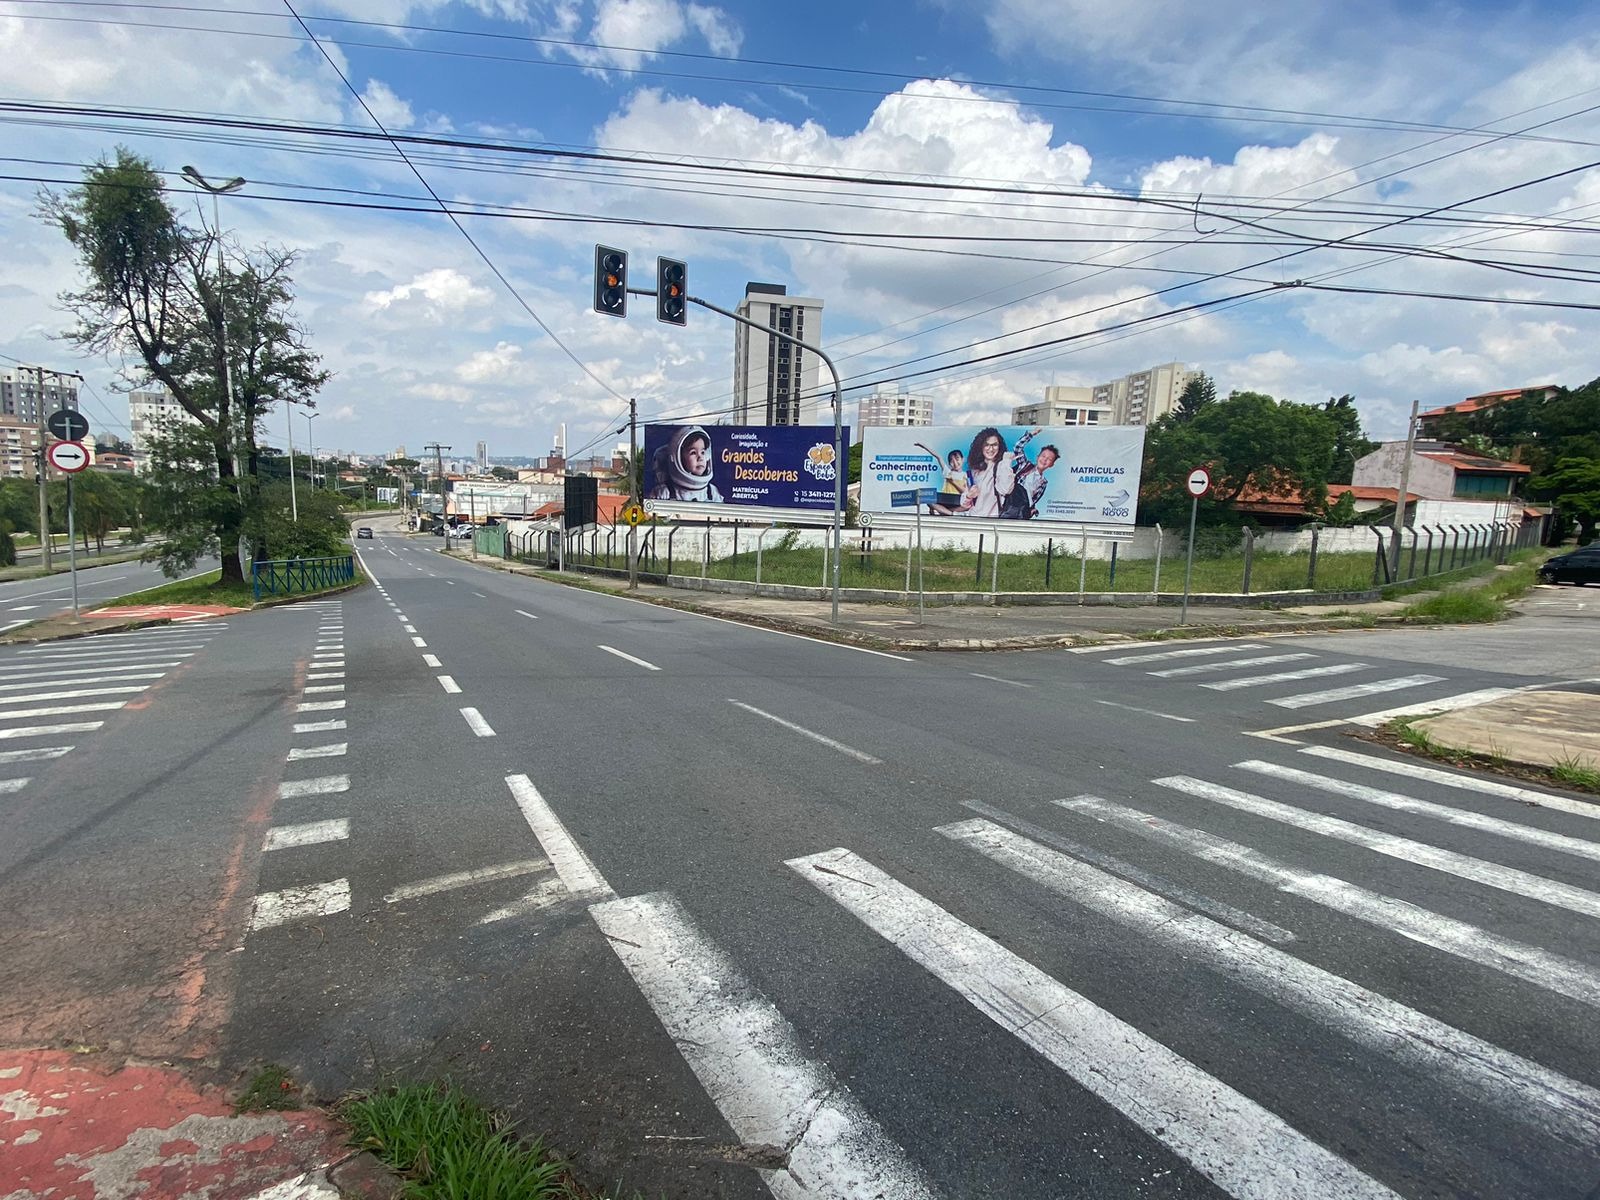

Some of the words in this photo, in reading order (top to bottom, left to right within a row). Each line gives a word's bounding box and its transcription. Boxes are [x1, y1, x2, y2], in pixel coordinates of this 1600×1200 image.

[722, 448, 764, 464] Grandes
[869, 462, 938, 471] Conhecimento
[1071, 465, 1125, 474] MATRÍCULAS
[735, 465, 798, 481] Descobertas
[877, 473, 893, 481] em
[897, 472, 929, 484] ação!
